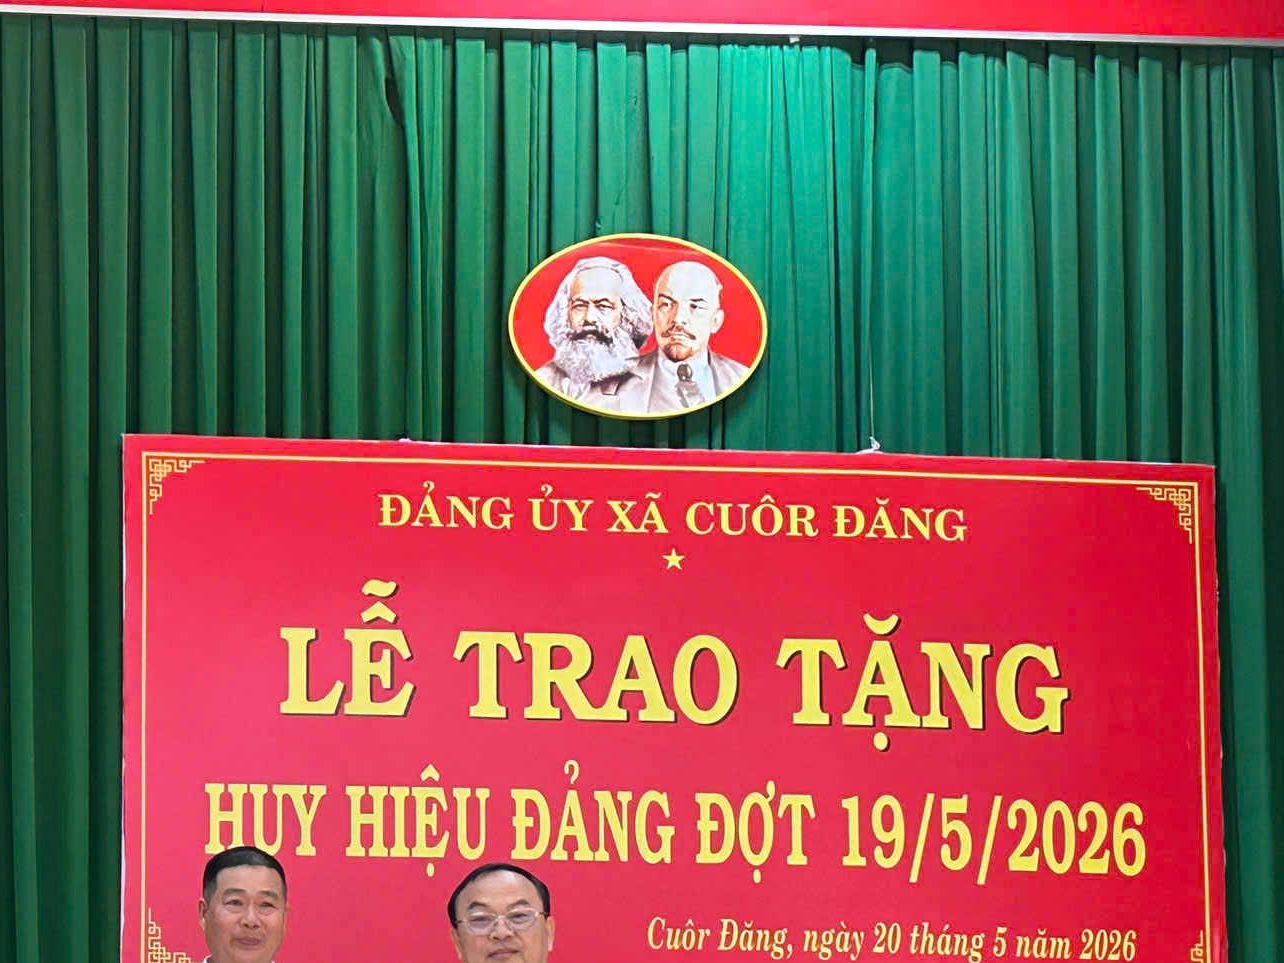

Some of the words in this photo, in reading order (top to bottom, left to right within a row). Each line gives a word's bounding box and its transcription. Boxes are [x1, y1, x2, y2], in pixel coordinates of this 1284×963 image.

[378, 481, 514, 530] ĐẢNG
[529, 484, 593, 533] ỦY
[606, 490, 669, 534] XÃ
[684, 494, 819, 538] CUÔR
[834, 498, 966, 542] ĐĂNG
[278, 578, 416, 718] LỄ
[452, 629, 739, 726] TRAO
[774, 612, 1070, 752] TẶNG
[203, 782, 328, 857] HUY
[344, 764, 492, 878] HIỆU
[509, 758, 676, 866] ĐẢNG
[693, 780, 817, 885] ĐỢT
[840, 792, 1147, 886] 19/5/2026
[646, 917, 711, 951] Cuôr
[718, 917, 794, 961] Đăng,
[803, 920, 865, 962] ngày
[872, 922, 903, 955] 20
[992, 926, 1009, 958] 5
[1015, 929, 1073, 960] năm
[1079, 929, 1138, 962] 2026
